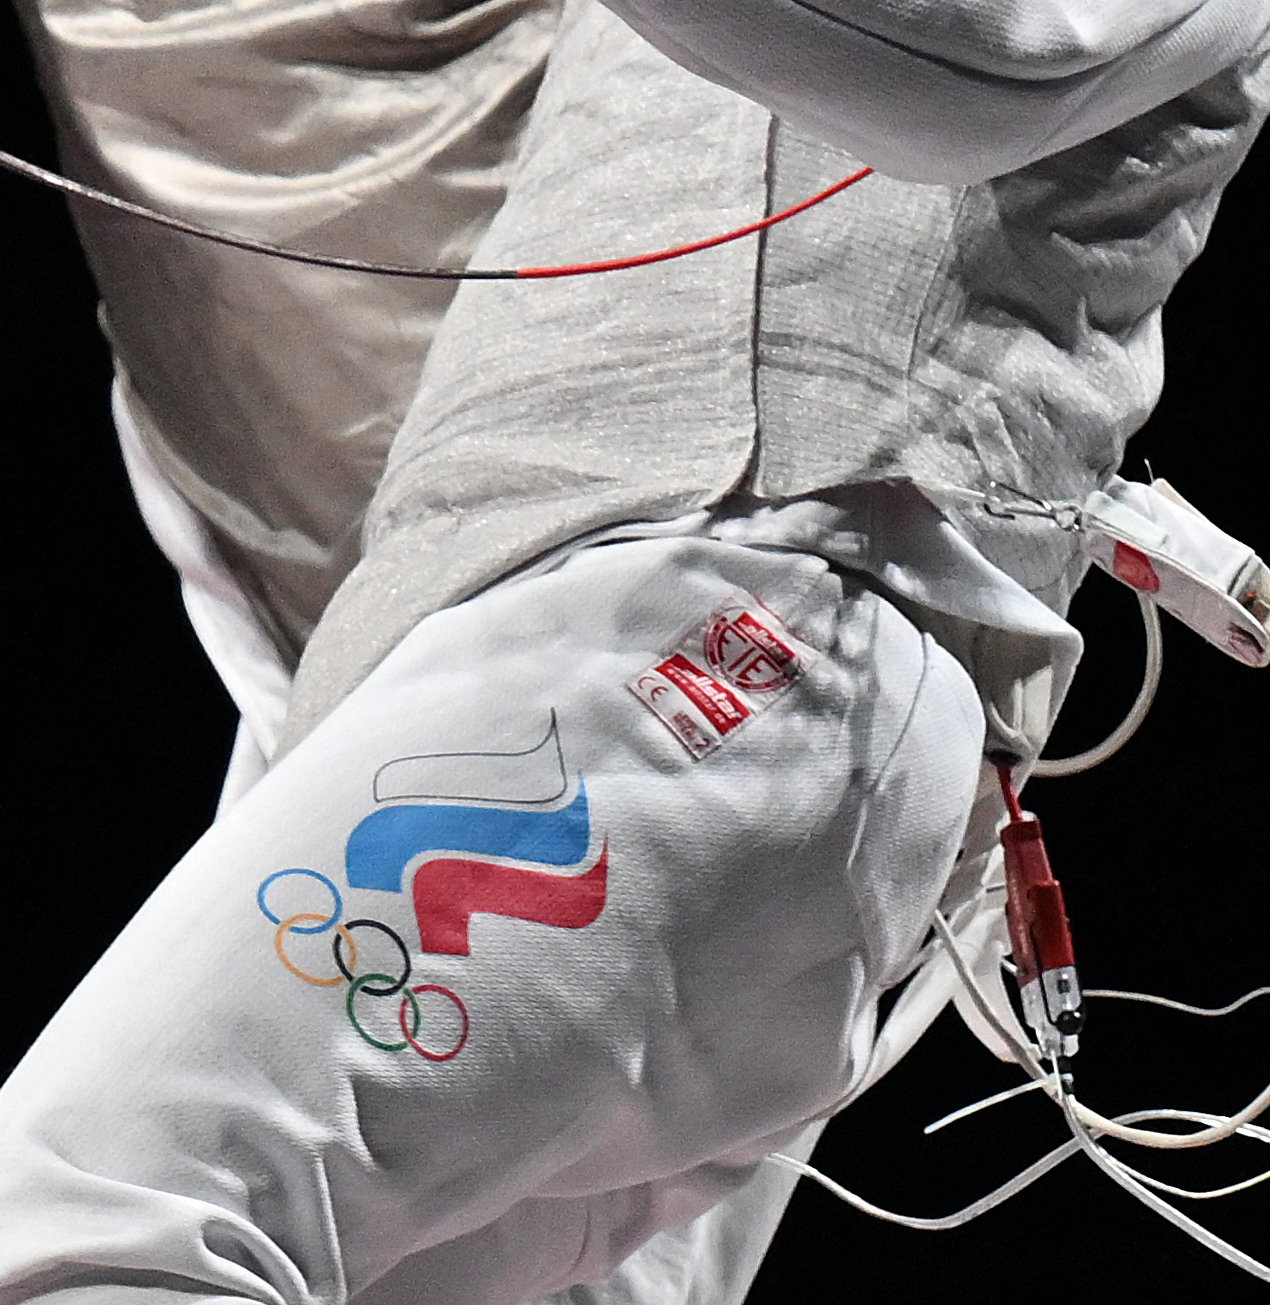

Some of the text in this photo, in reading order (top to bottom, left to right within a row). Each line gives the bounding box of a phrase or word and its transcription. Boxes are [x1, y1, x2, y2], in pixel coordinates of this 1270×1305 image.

[721, 622, 779, 682] FIE
[636, 675, 669, 702] CE
[668, 663, 743, 719] allstar
